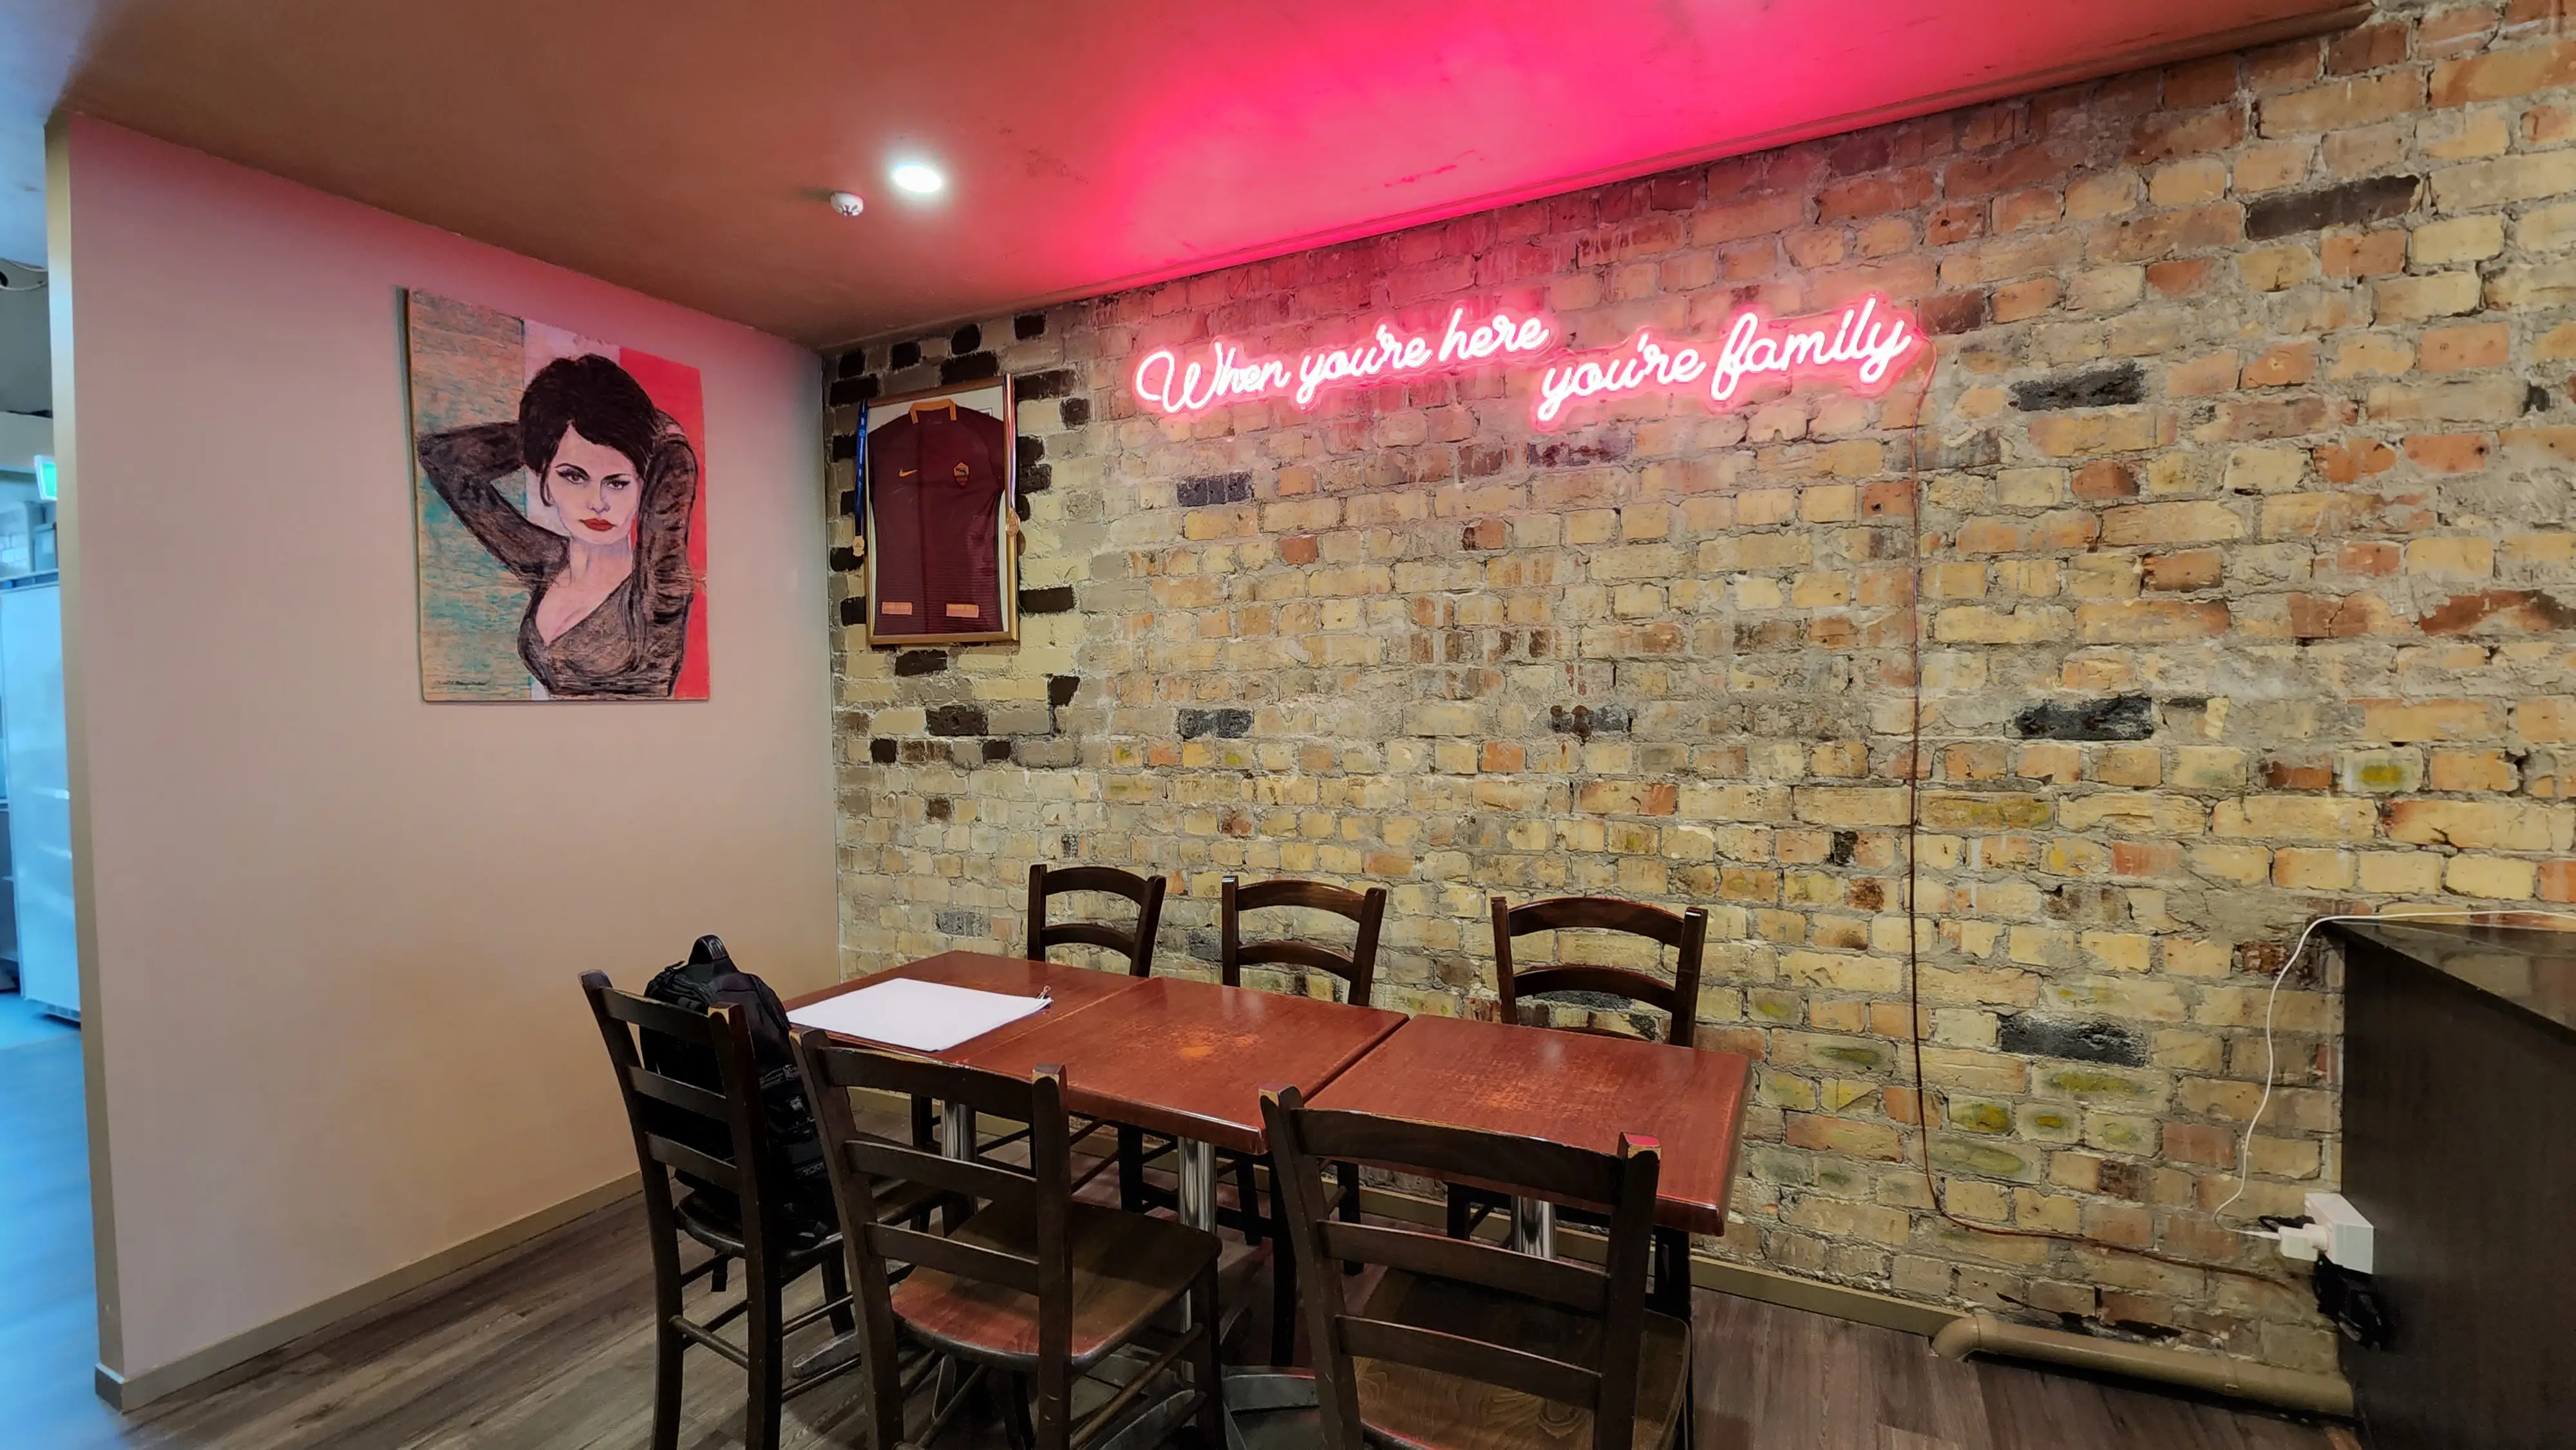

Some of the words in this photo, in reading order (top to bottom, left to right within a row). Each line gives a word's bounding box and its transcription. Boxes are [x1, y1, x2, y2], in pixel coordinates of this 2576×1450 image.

[1135, 341, 1292, 413] When
[1296, 324, 1433, 404] you're
[1437, 308, 1549, 362] here
[1537, 333, 1707, 422] you're
[1710, 297, 1913, 400] family
